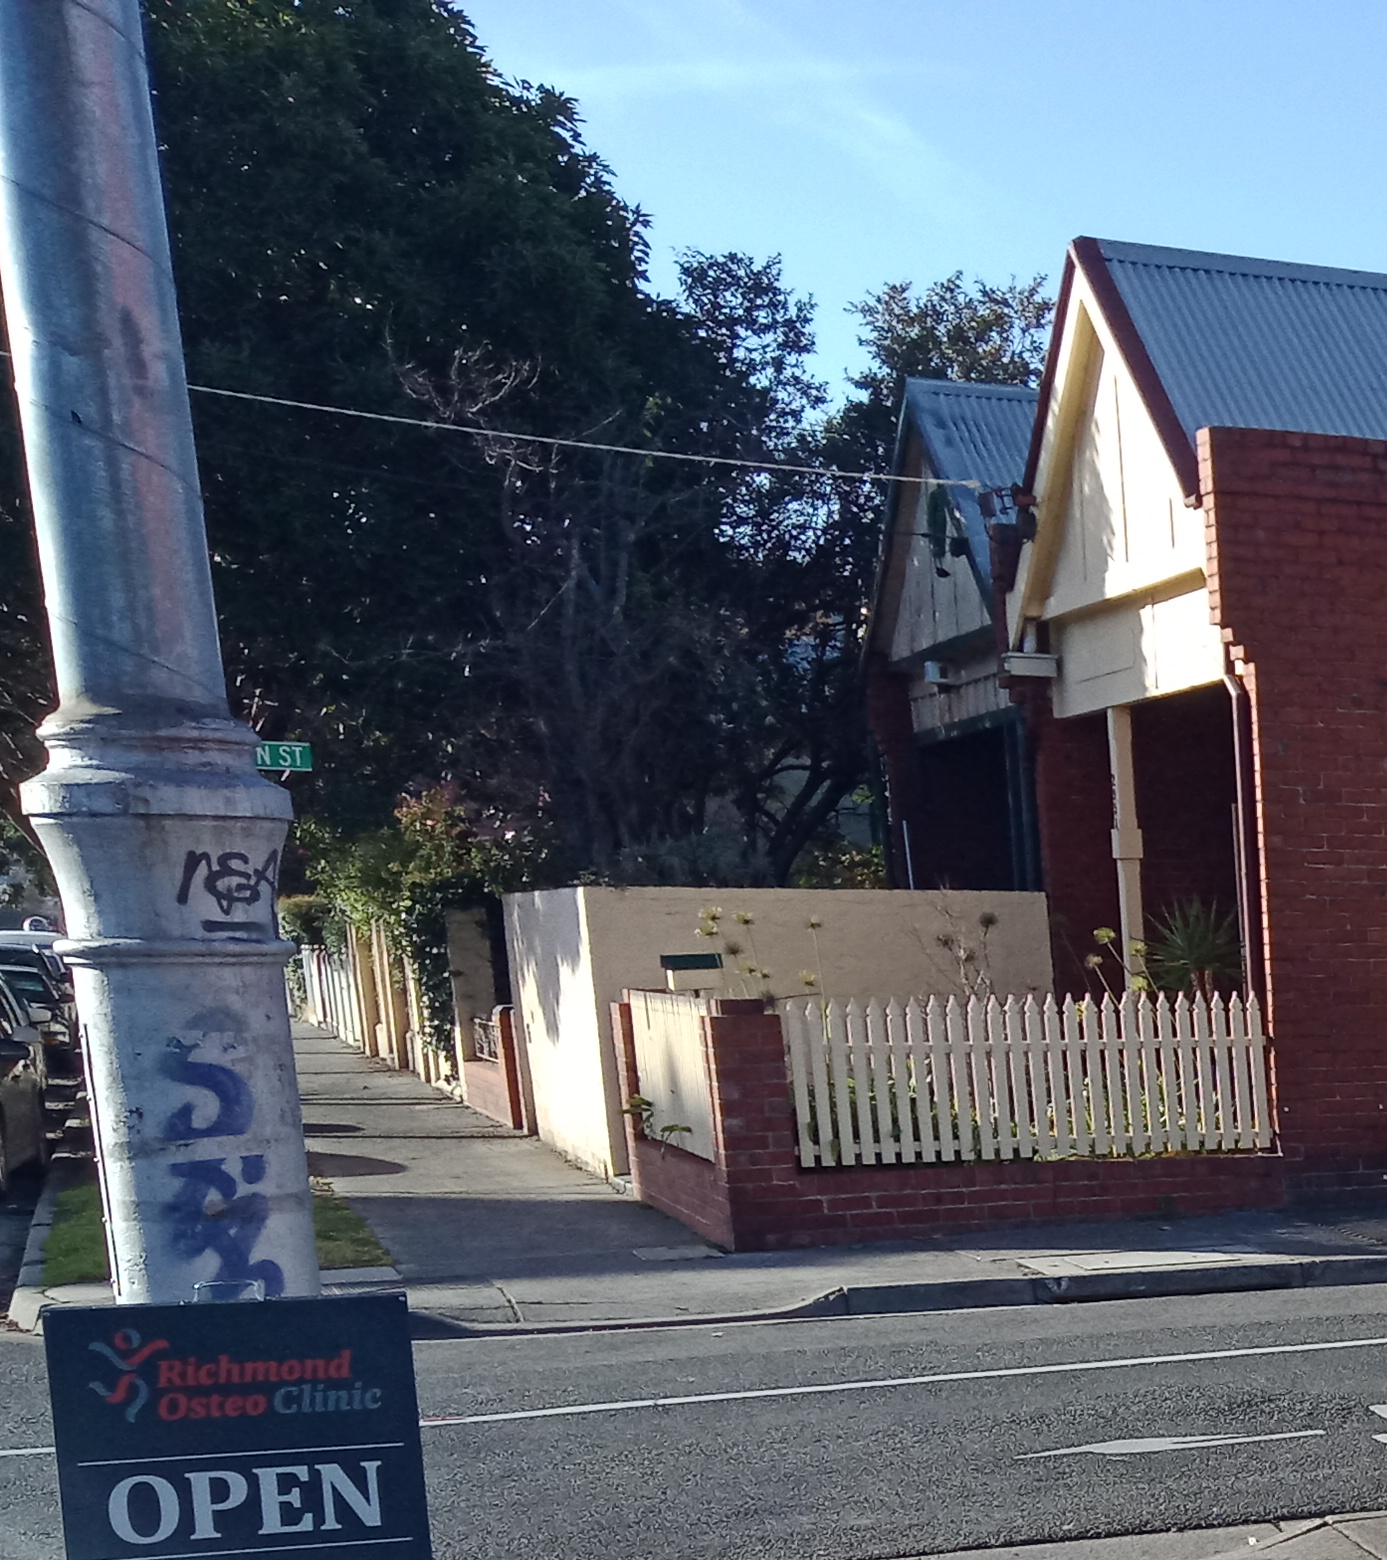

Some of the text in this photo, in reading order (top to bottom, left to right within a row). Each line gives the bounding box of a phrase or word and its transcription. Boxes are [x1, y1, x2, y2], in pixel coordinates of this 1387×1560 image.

[279, 746, 304, 767] ST
[157, 1348, 352, 1388] Richmond
[157, 1381, 383, 1421] Osteo Clinic
[107, 1460, 384, 1545] OPEN
